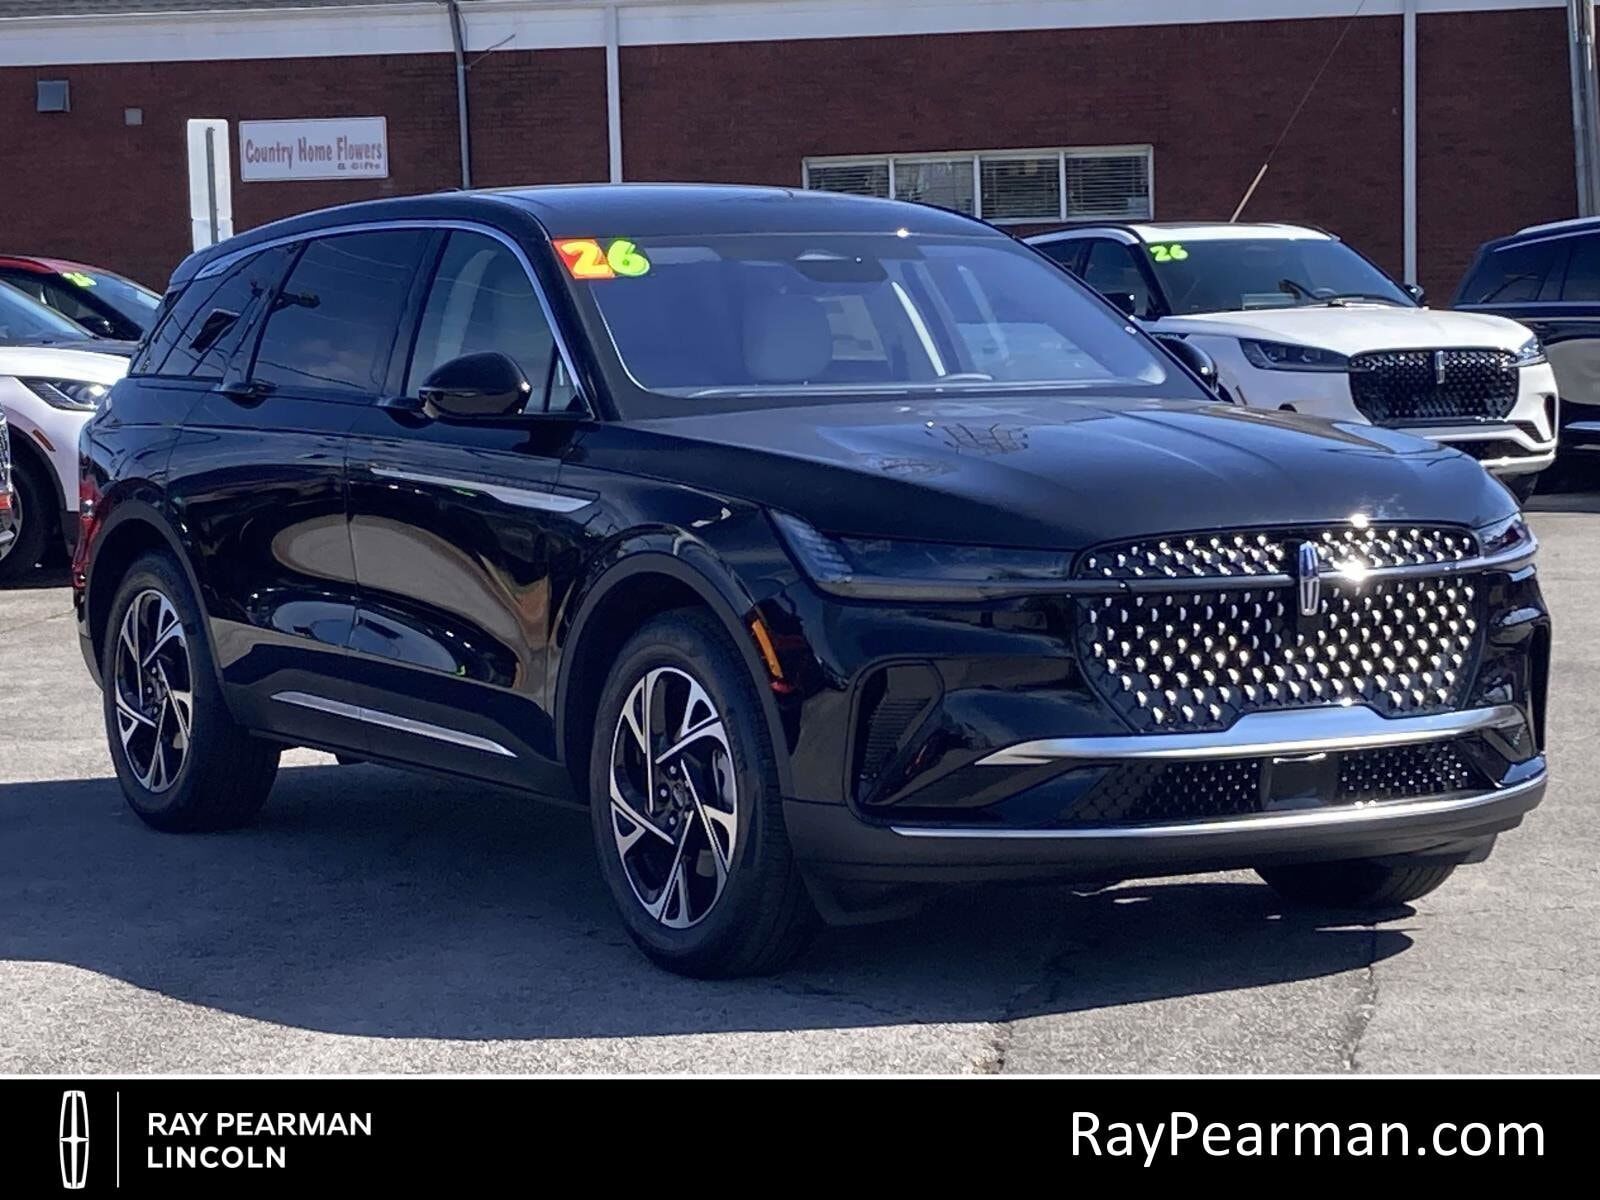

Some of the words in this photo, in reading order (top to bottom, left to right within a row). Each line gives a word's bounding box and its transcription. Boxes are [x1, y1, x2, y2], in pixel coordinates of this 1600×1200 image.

[245, 138, 294, 169] Country
[298, 136, 332, 162] Home
[336, 135, 382, 161] Flowers
[560, 240, 650, 277] 26
[1149, 244, 1189, 262] 26
